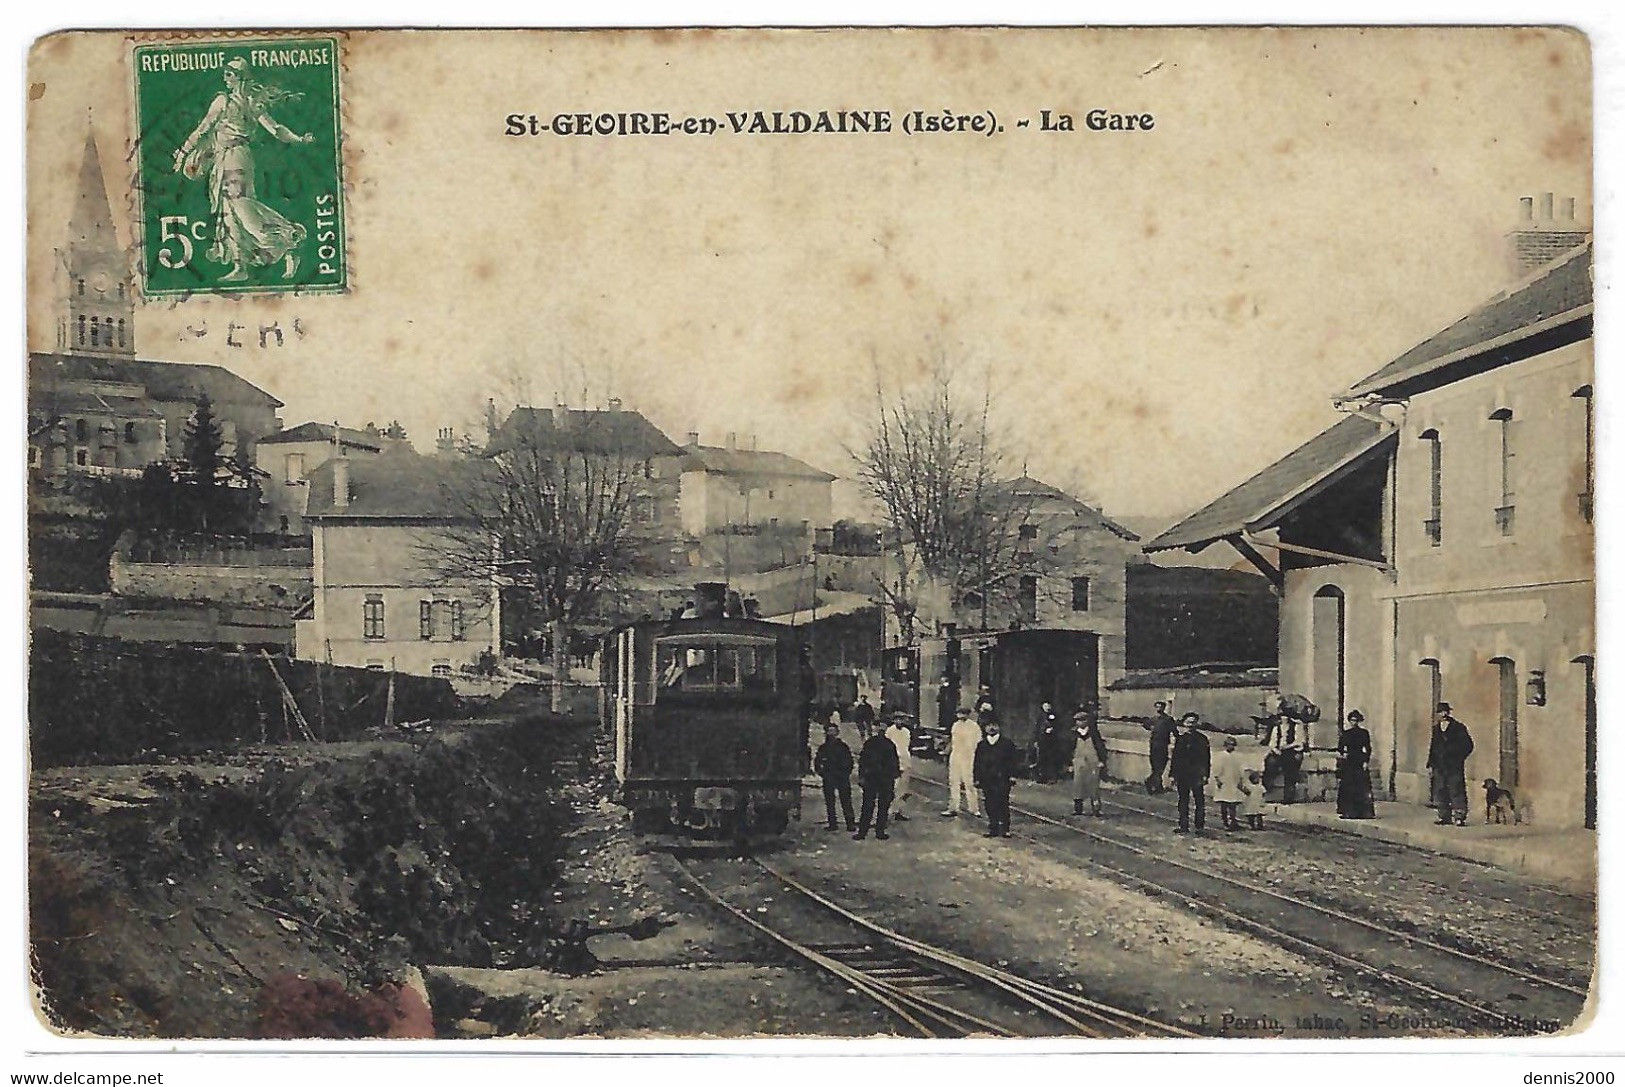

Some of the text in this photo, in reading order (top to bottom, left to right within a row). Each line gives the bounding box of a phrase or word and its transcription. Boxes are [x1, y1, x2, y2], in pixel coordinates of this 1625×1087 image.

[250, 48, 329, 69] FRANÇAISE
[901, 109, 1004, 138] (Isère).
[1039, 109, 1075, 132] La
[1085, 108, 1156, 132] Gare
[315, 193, 337, 275] POSTES
